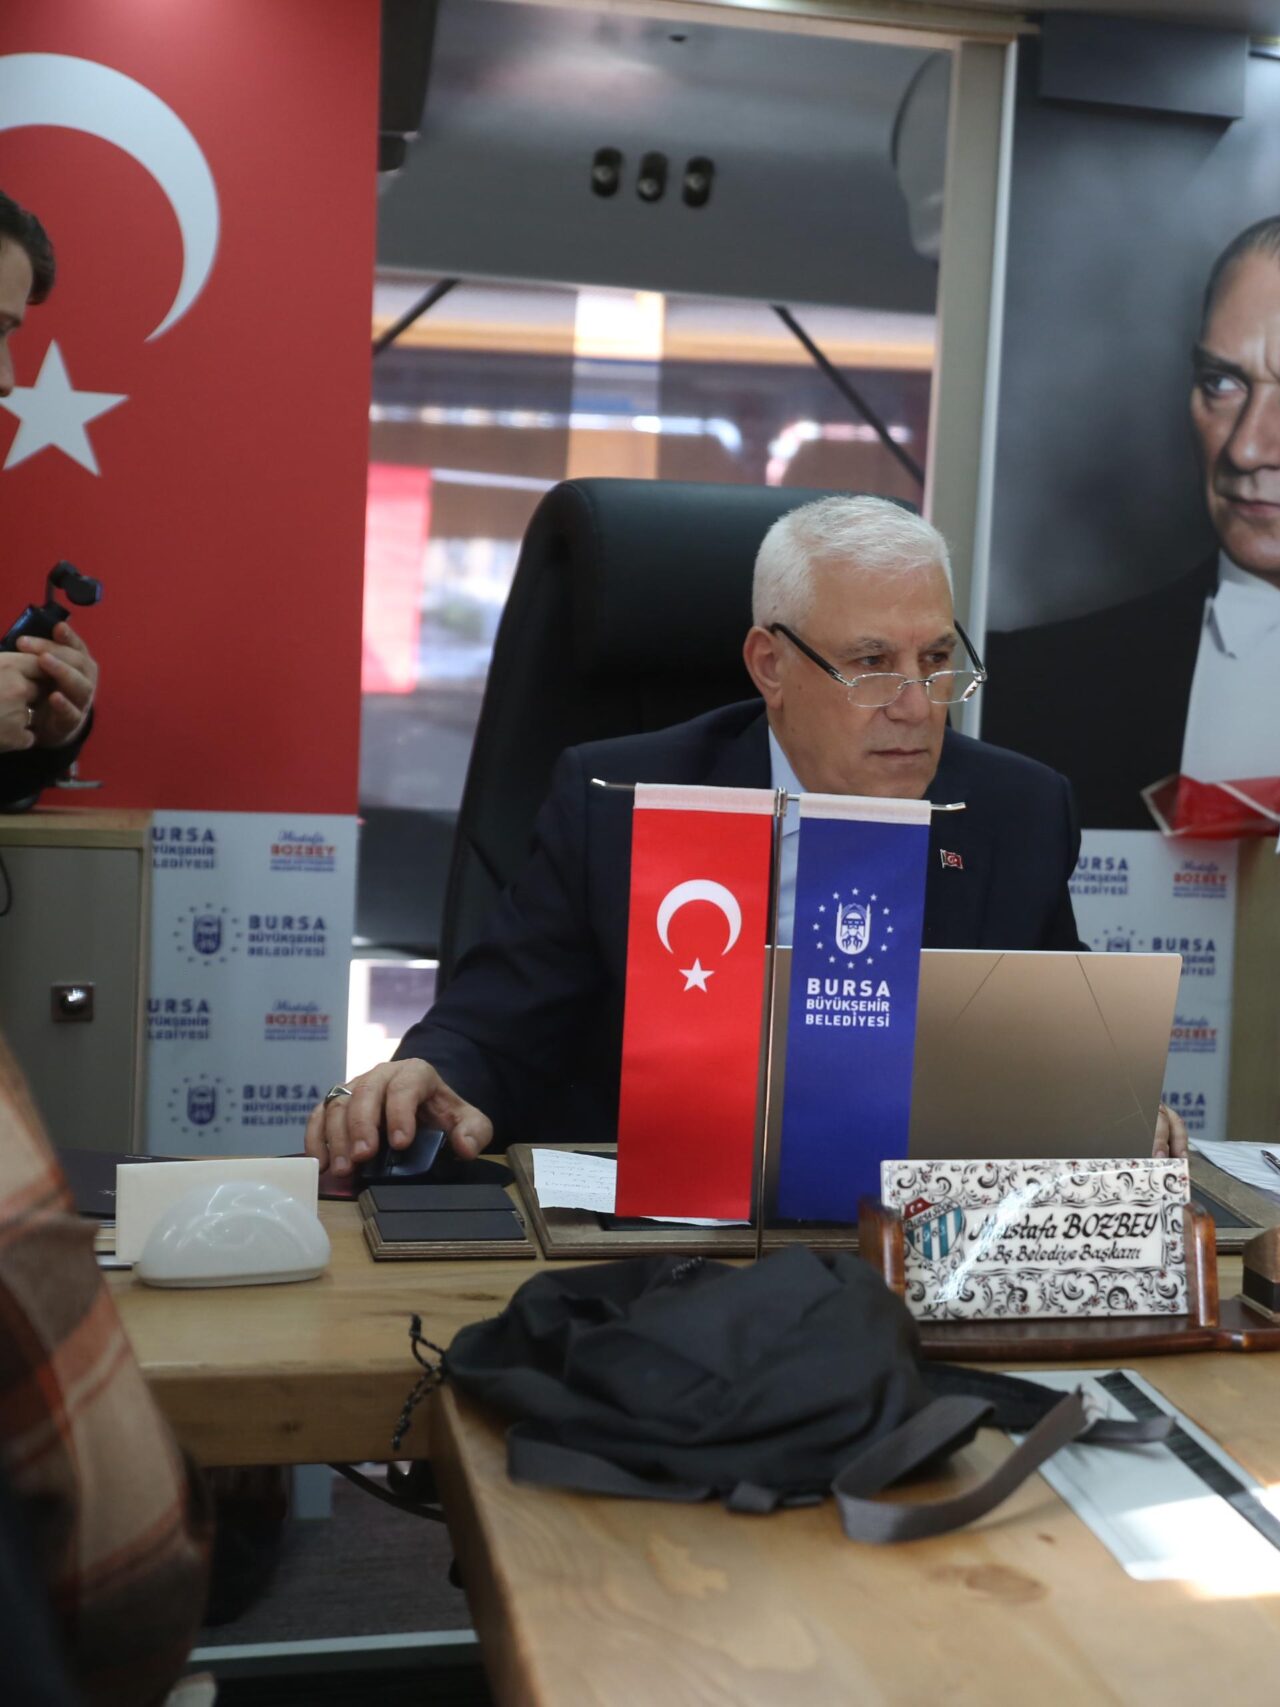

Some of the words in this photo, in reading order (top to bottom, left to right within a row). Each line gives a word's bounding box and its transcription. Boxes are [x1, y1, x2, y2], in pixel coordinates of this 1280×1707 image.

[151, 827, 214, 842] URSA
[1077, 857, 1128, 871] URSA
[248, 915, 327, 931] BURSA
[1152, 937, 1216, 952] BURSA
[807, 977, 890, 997] BURSA
[146, 998, 210, 1013] URSA
[806, 996, 890, 1012] BÜYÜKŞEHİR
[805, 1011, 890, 1027] BELEDİYESİ
[243, 1084, 320, 1099] BURSA
[1062, 1212, 1158, 1240] BOZBEY
